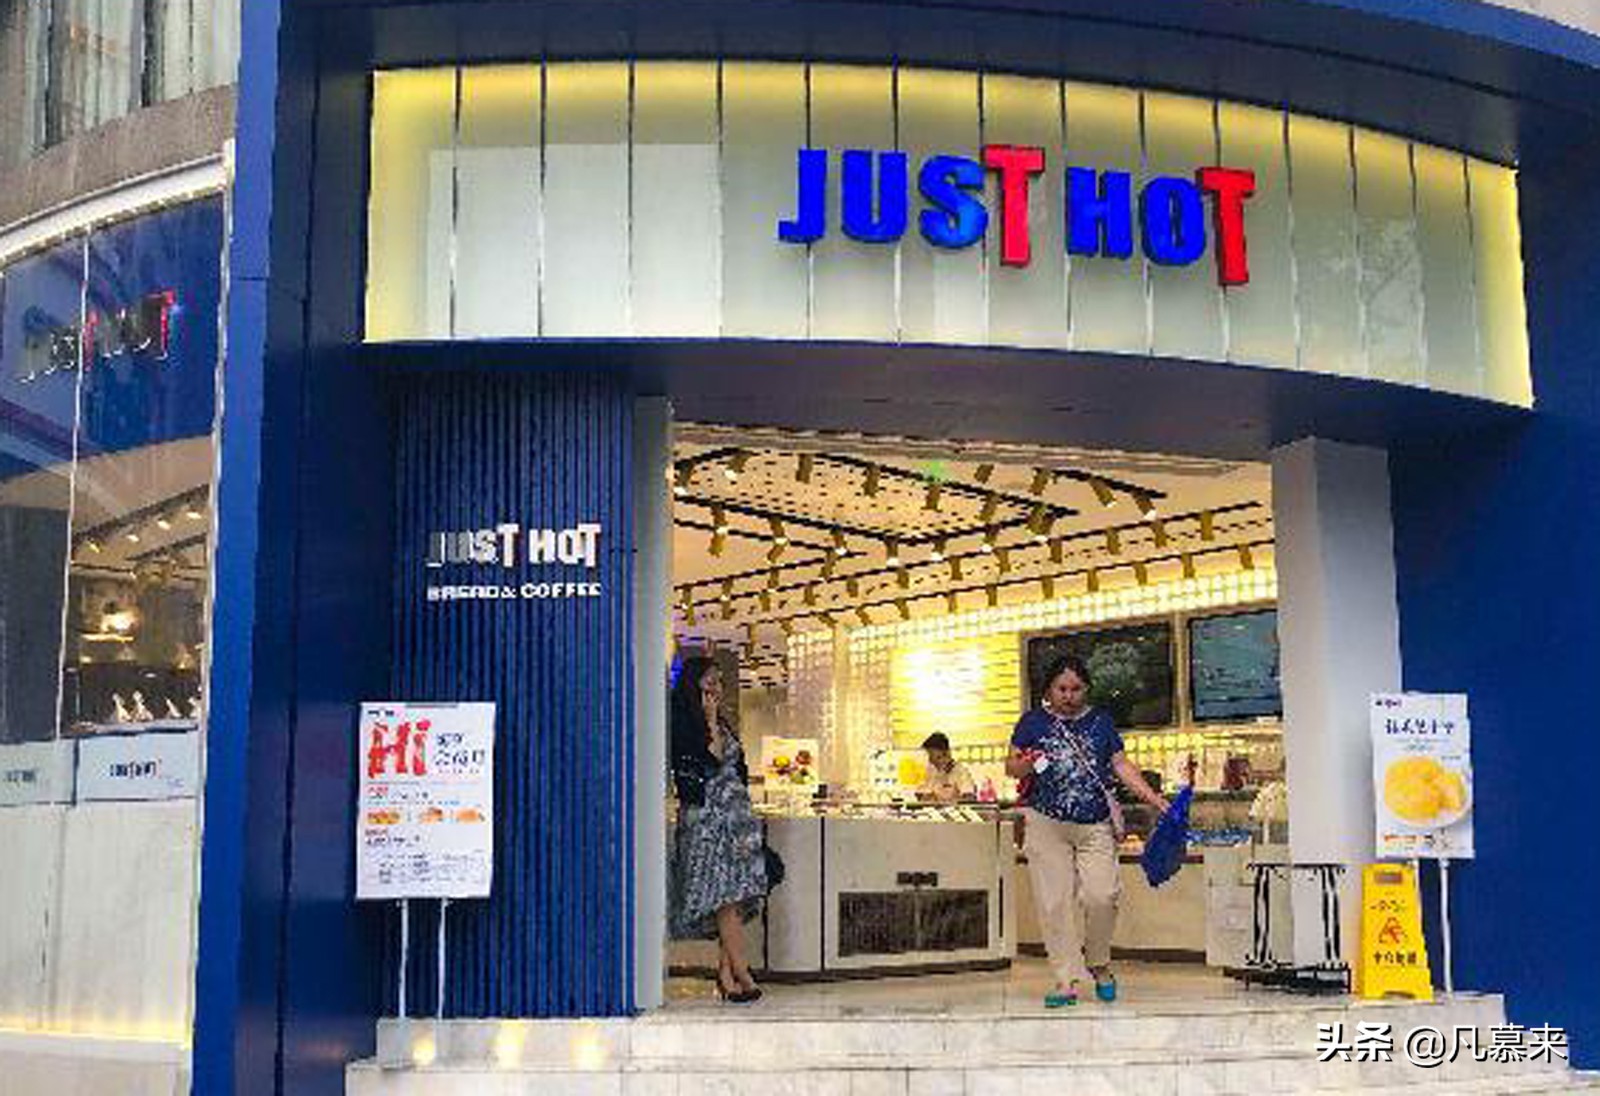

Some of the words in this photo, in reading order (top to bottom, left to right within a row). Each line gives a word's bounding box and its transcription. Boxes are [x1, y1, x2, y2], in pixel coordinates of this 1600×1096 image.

[778, 144, 1046, 268] JUST
[1065, 166, 1256, 287] HOT
[426, 523, 520, 568] JUST
[528, 523, 602, 568] HOT
[520, 582, 602, 599] COFFEE
[367, 720, 432, 779] Hi
